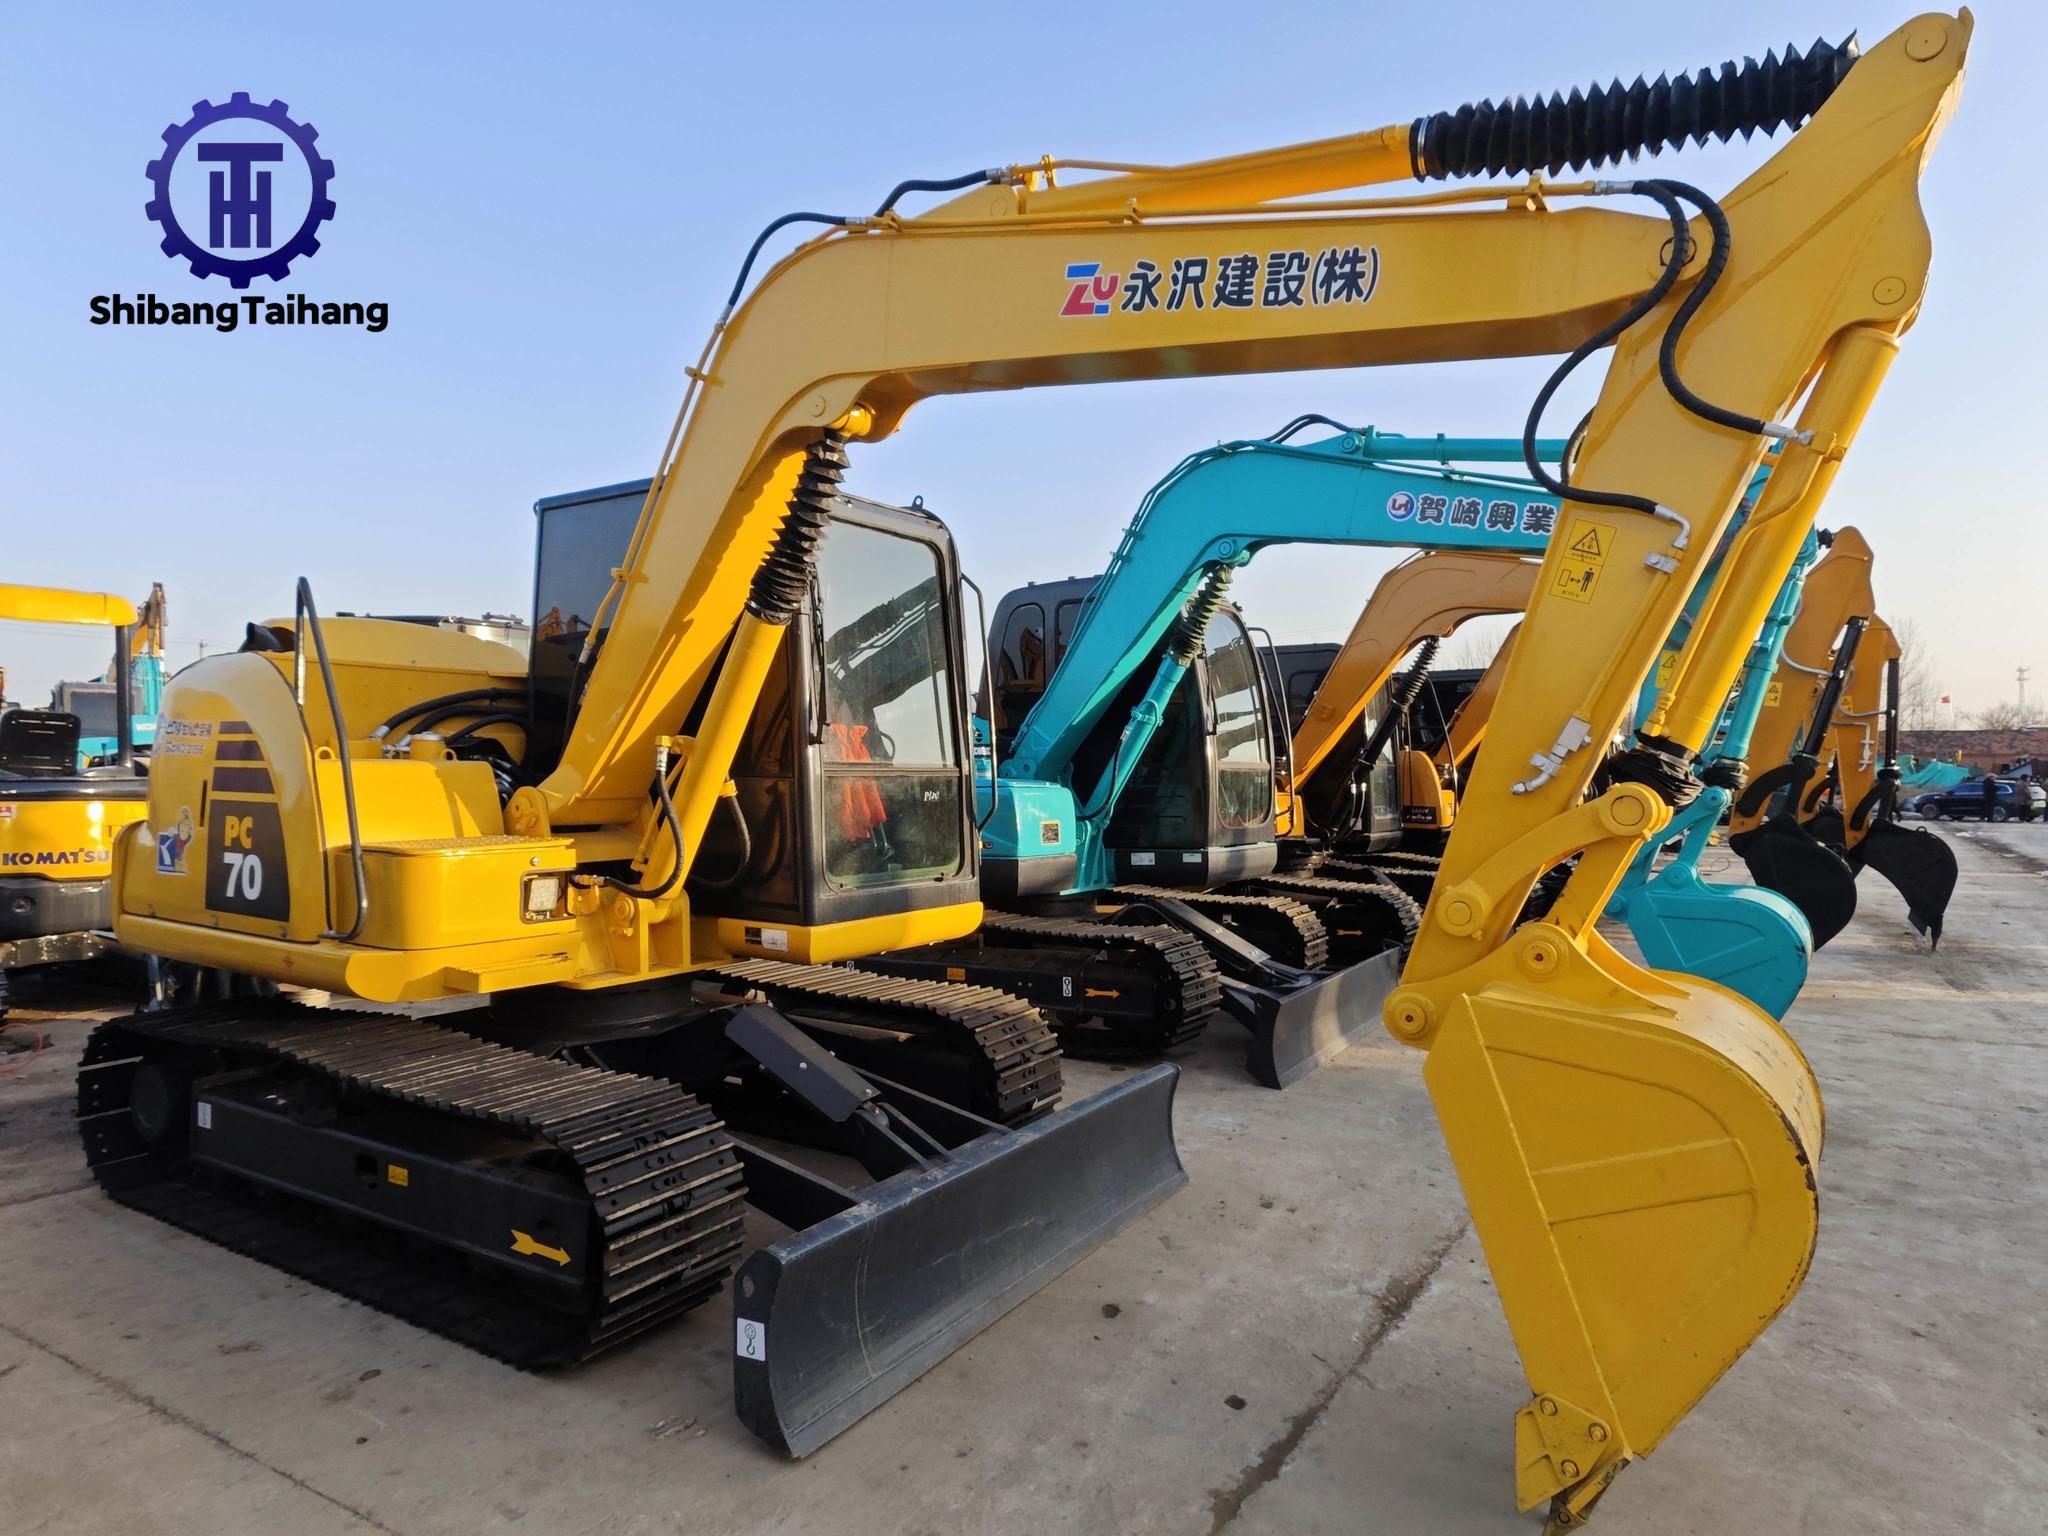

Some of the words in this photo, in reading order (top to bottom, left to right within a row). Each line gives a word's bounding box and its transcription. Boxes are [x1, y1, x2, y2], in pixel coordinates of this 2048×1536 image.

[224, 815, 254, 849] PC
[1, 847, 111, 867] KOMATSU
[223, 851, 263, 901] 70
